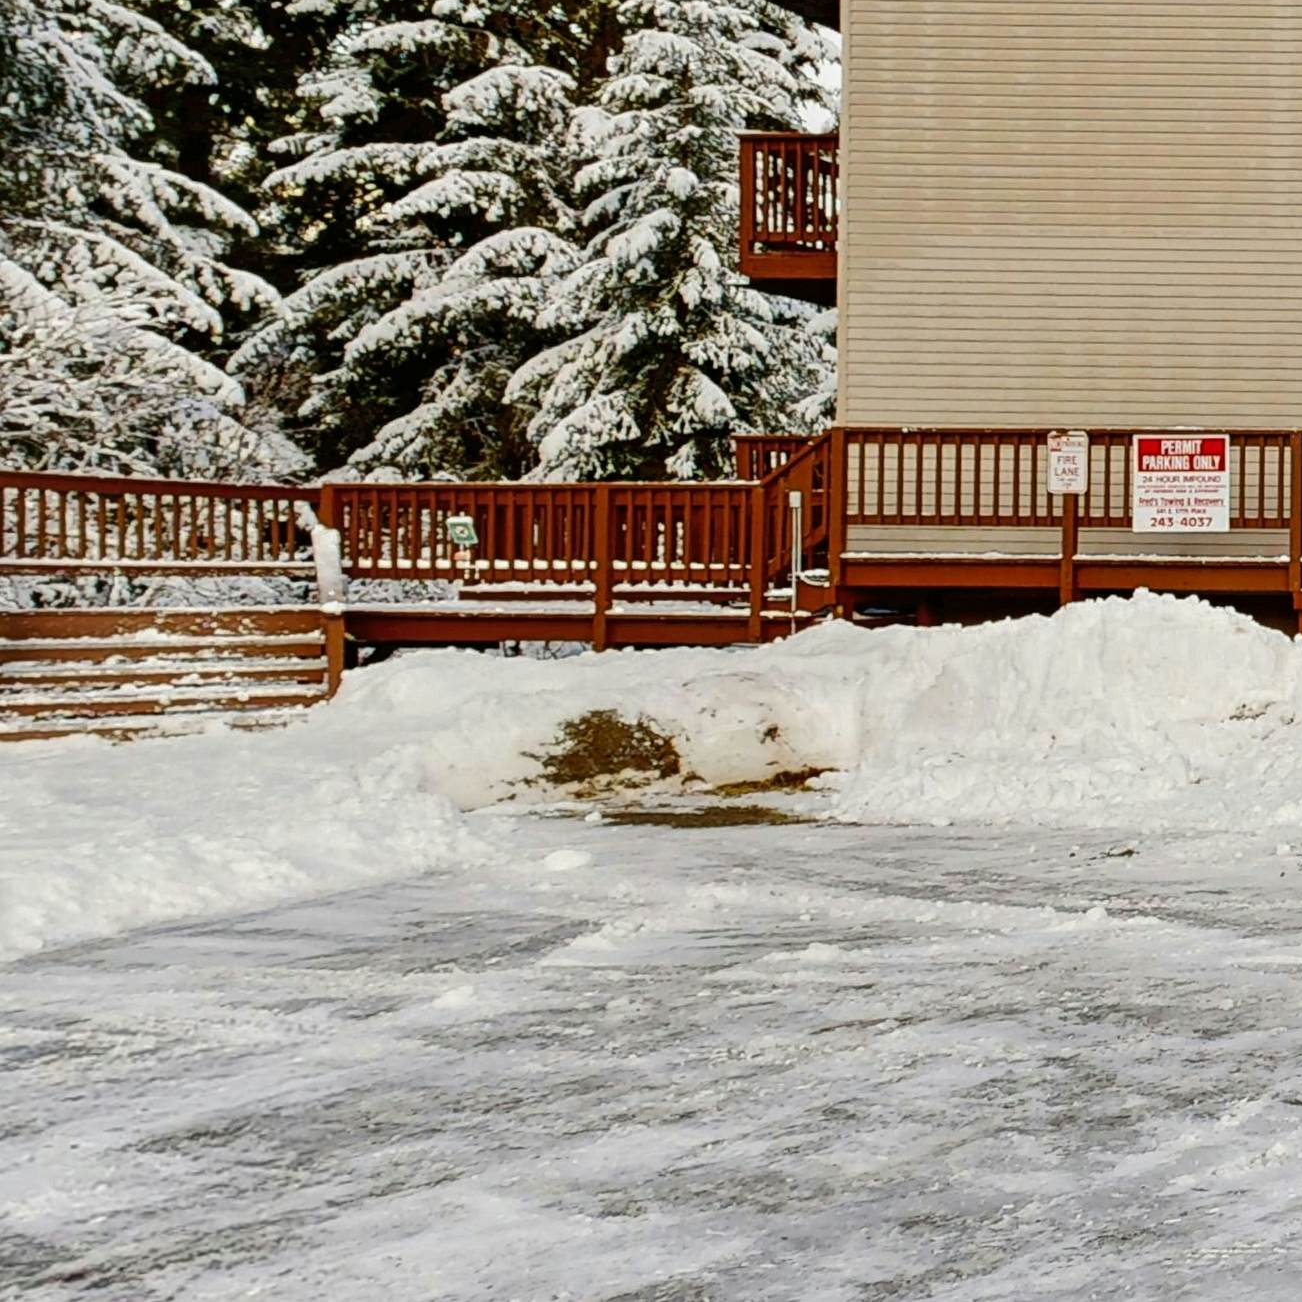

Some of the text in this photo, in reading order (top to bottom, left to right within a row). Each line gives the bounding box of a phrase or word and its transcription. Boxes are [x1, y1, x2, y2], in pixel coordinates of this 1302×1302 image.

[1161, 440, 1203, 455] PERMIT
[1142, 455, 1221, 470] PARKING ONLY
[1054, 467, 1080, 477] LANE
[1142, 476, 1153, 484] 24
[1183, 475, 1221, 483] IMPOUND
